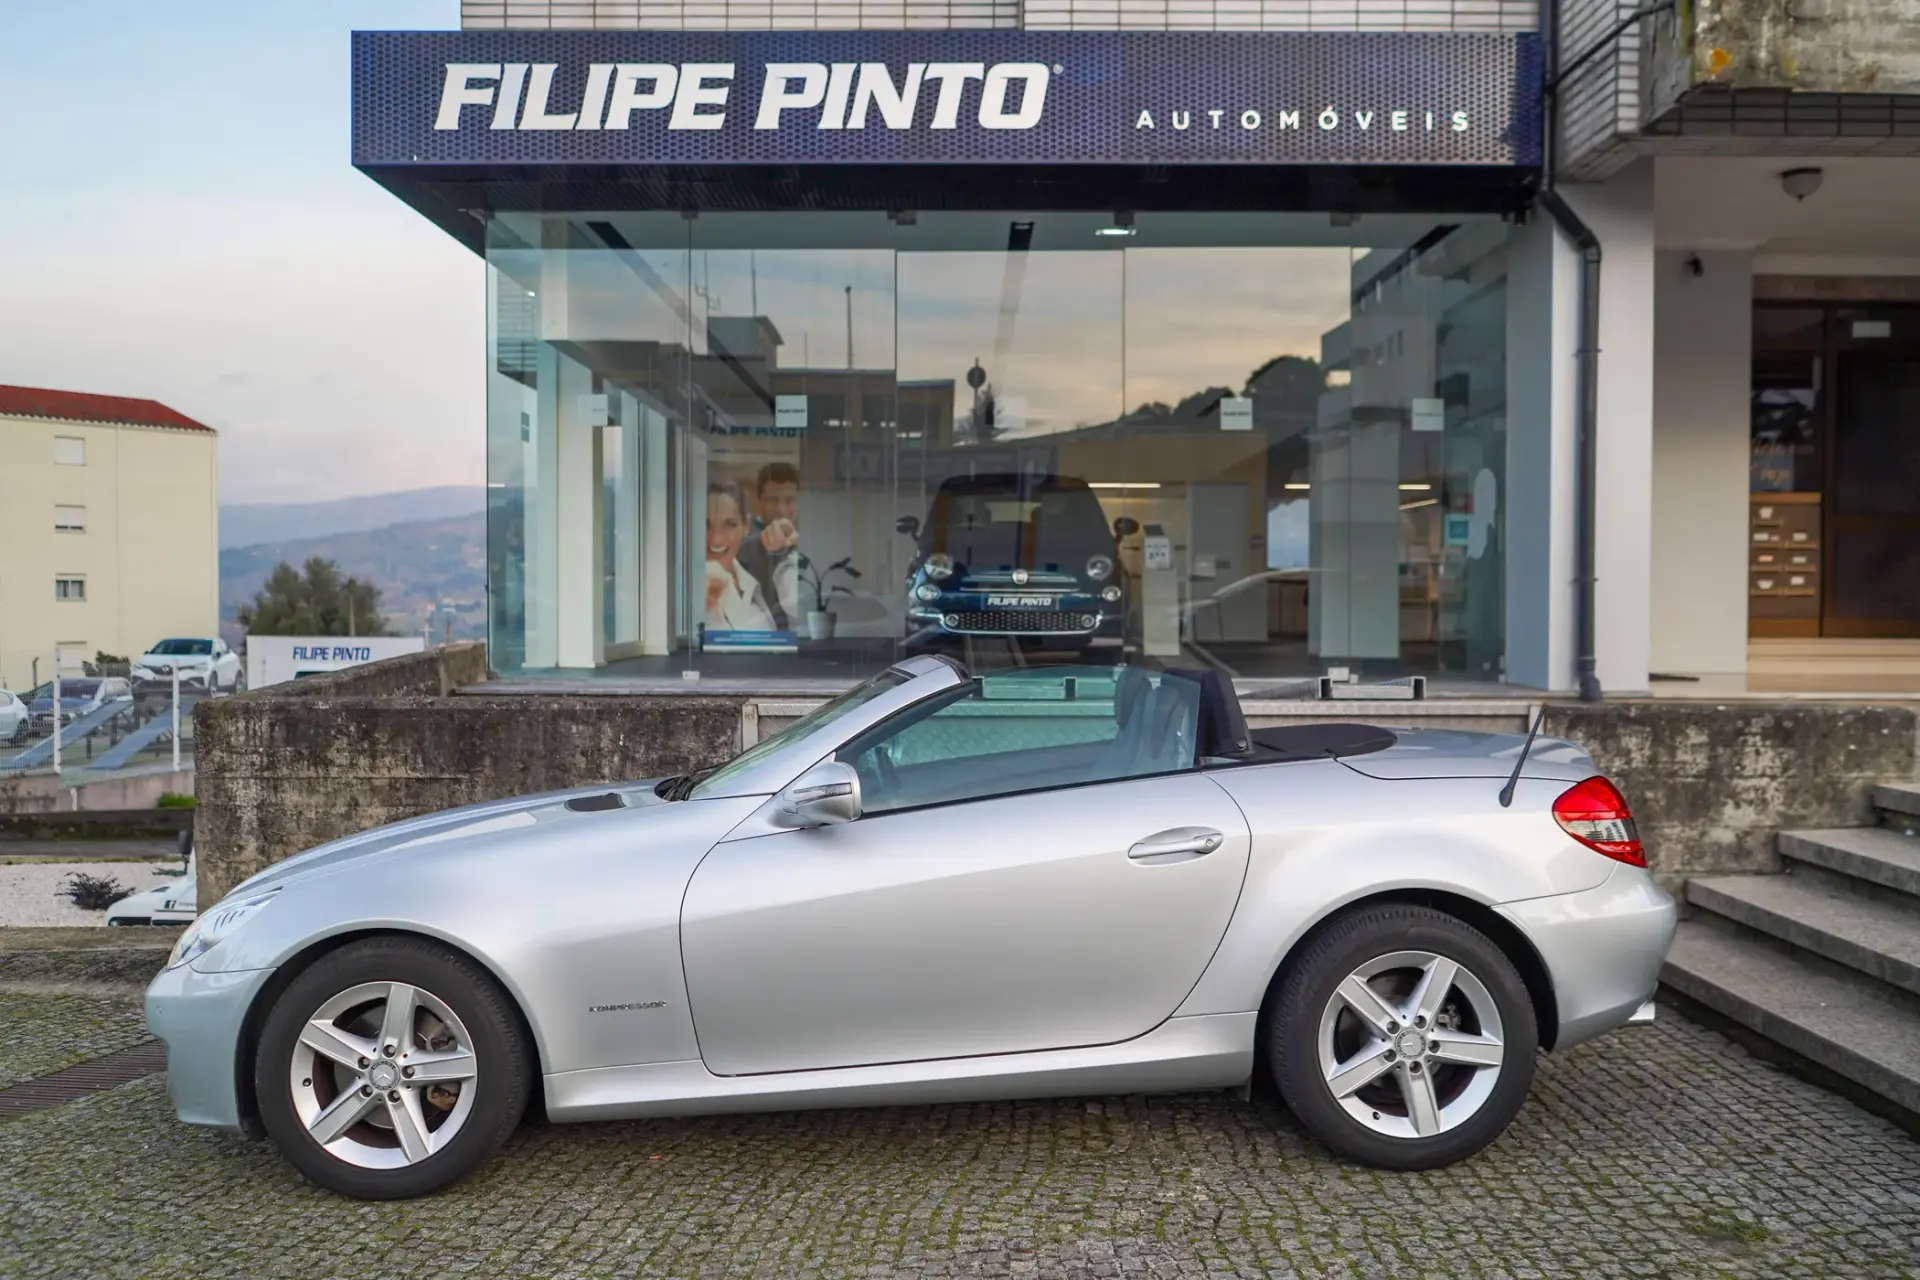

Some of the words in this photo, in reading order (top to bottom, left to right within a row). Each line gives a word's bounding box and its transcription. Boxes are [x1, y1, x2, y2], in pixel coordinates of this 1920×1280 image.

[434, 62, 735, 131] FILIPE
[753, 62, 1050, 131] PINTO
[1136, 105, 1469, 131] AUTOMÓVEIS
[987, 597, 1019, 606] FILIPE
[1020, 597, 1052, 606] PINTO
[292, 646, 329, 660] FILIPE
[333, 647, 371, 661] PINTO
